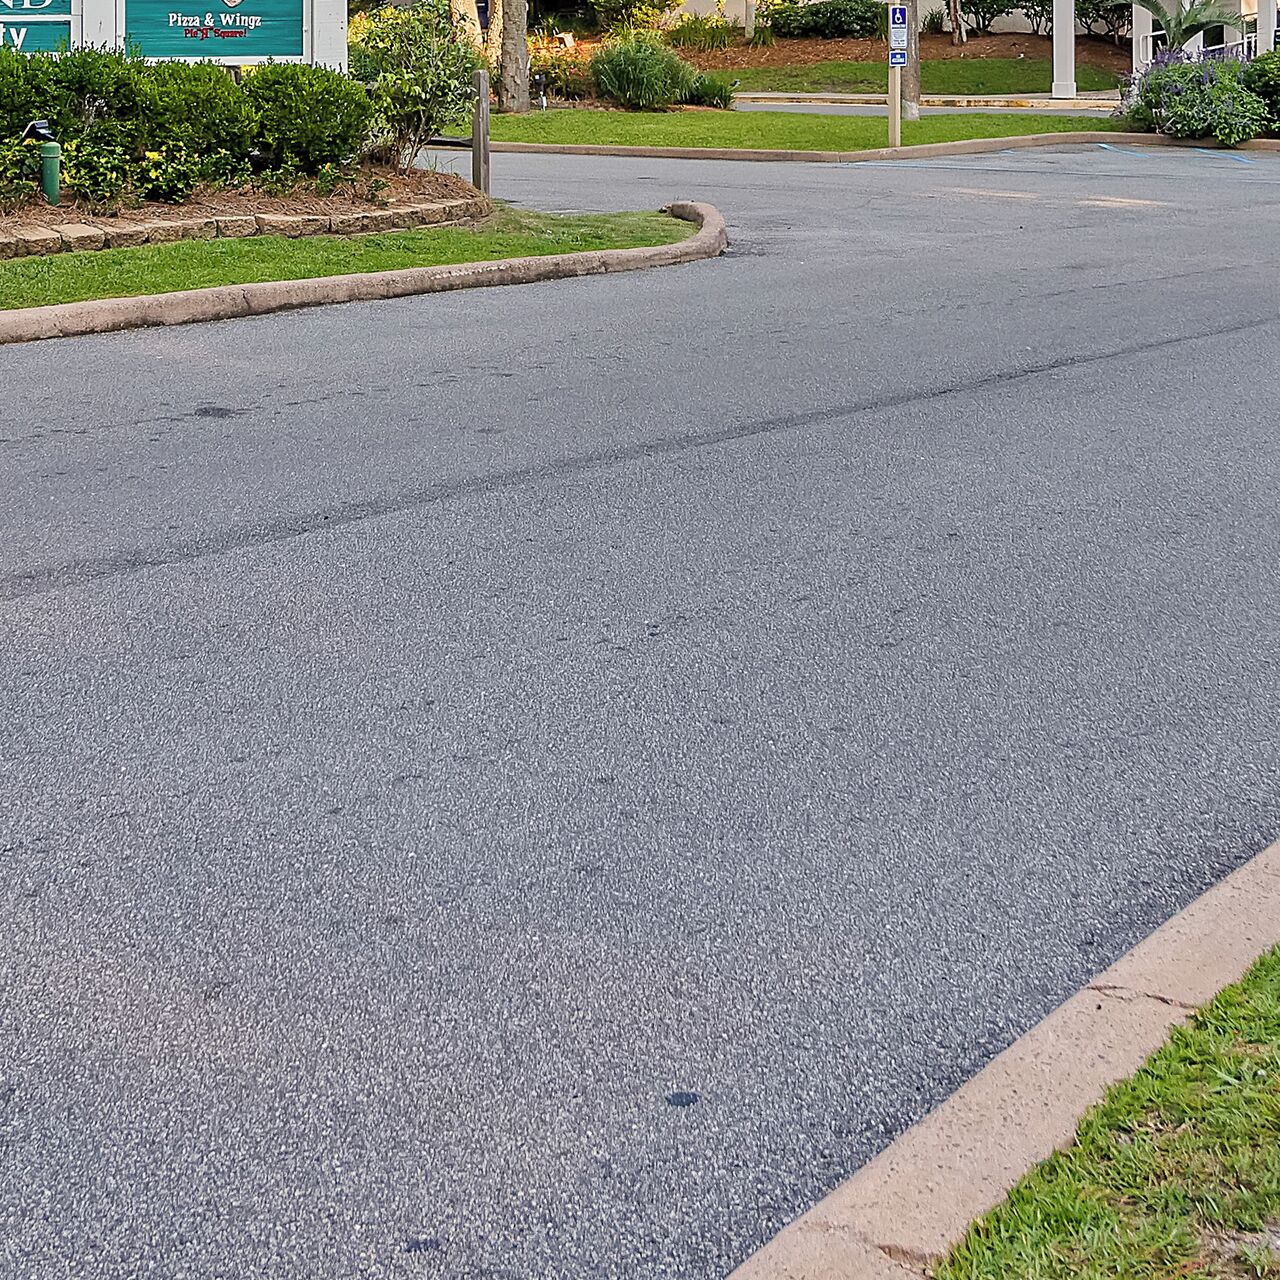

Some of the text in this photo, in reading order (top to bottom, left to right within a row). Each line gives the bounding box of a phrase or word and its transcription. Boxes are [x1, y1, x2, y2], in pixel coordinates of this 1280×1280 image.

[168, 12, 262, 29] Pizza & Wingz
